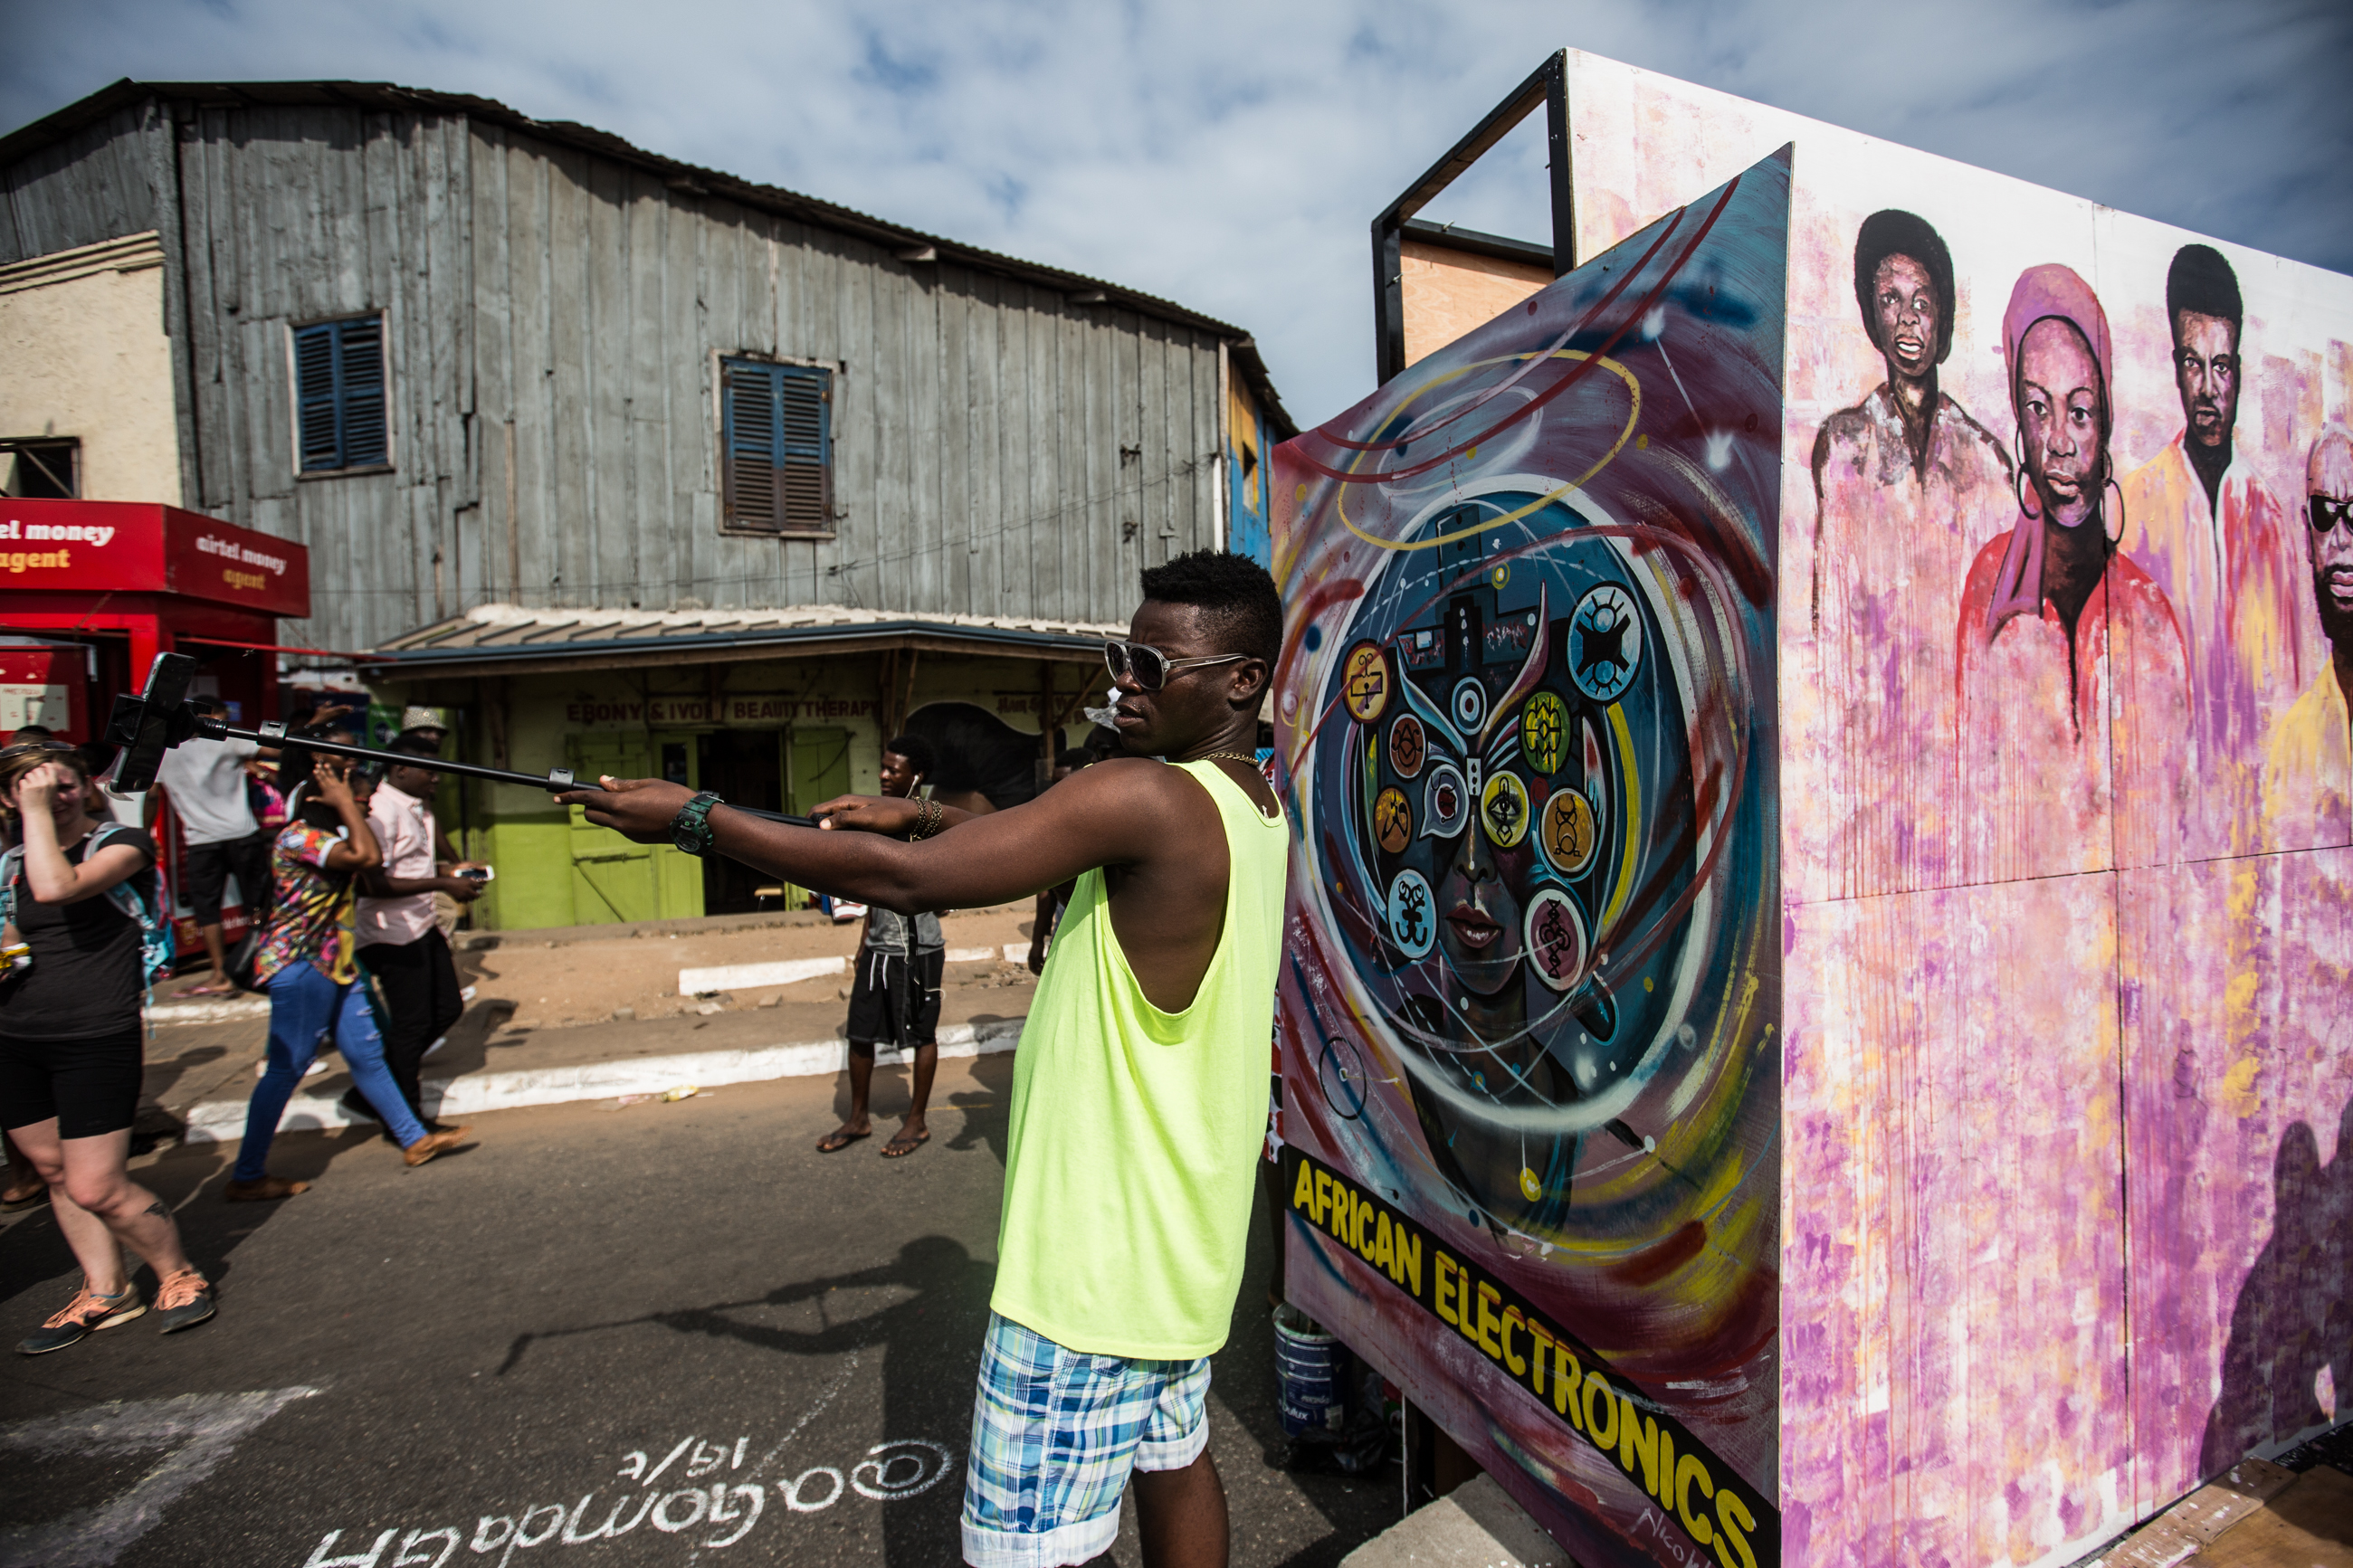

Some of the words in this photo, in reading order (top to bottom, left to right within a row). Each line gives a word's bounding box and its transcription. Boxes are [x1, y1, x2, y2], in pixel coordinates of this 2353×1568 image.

[24, 524, 115, 546] money
[0, 548, 71, 573] agent
[195, 534, 240, 560] airtel
[241, 548, 287, 576] money
[223, 568, 266, 591] agent
[566, 703, 642, 722] EBONY
[649, 702, 664, 720] &
[733, 701, 800, 719] BEAUTY
[802, 699, 881, 717] THERAPY
[1293, 1159, 1422, 1297] AFRICAN
[1434, 1250, 1758, 1568] ELECTRONICS
